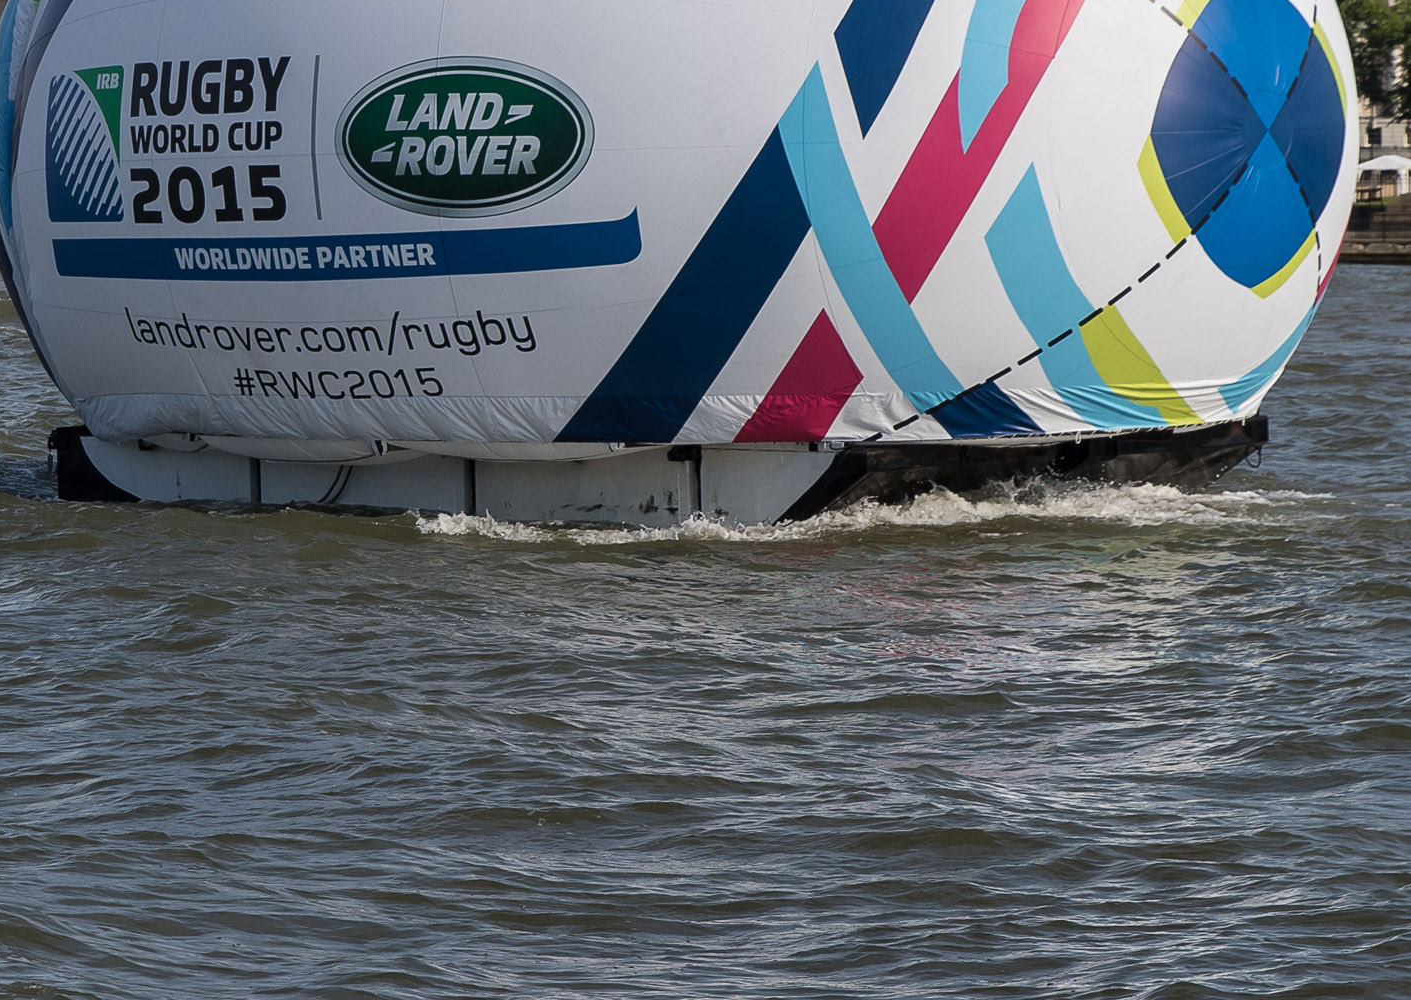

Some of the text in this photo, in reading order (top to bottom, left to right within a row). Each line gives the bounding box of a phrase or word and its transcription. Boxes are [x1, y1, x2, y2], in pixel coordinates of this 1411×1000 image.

[96, 72, 120, 90] IRB
[130, 56, 292, 117] RUGBY
[385, 92, 504, 131] LAND
[130, 119, 283, 154] WORLD CUP
[395, 135, 541, 176] ROVER
[129, 163, 287, 224] 2015
[174, 243, 437, 270] WORLDWIDE PARTNER
[124, 306, 538, 356] landrover.com/rugby
[234, 367, 444, 400] #RWC2015
